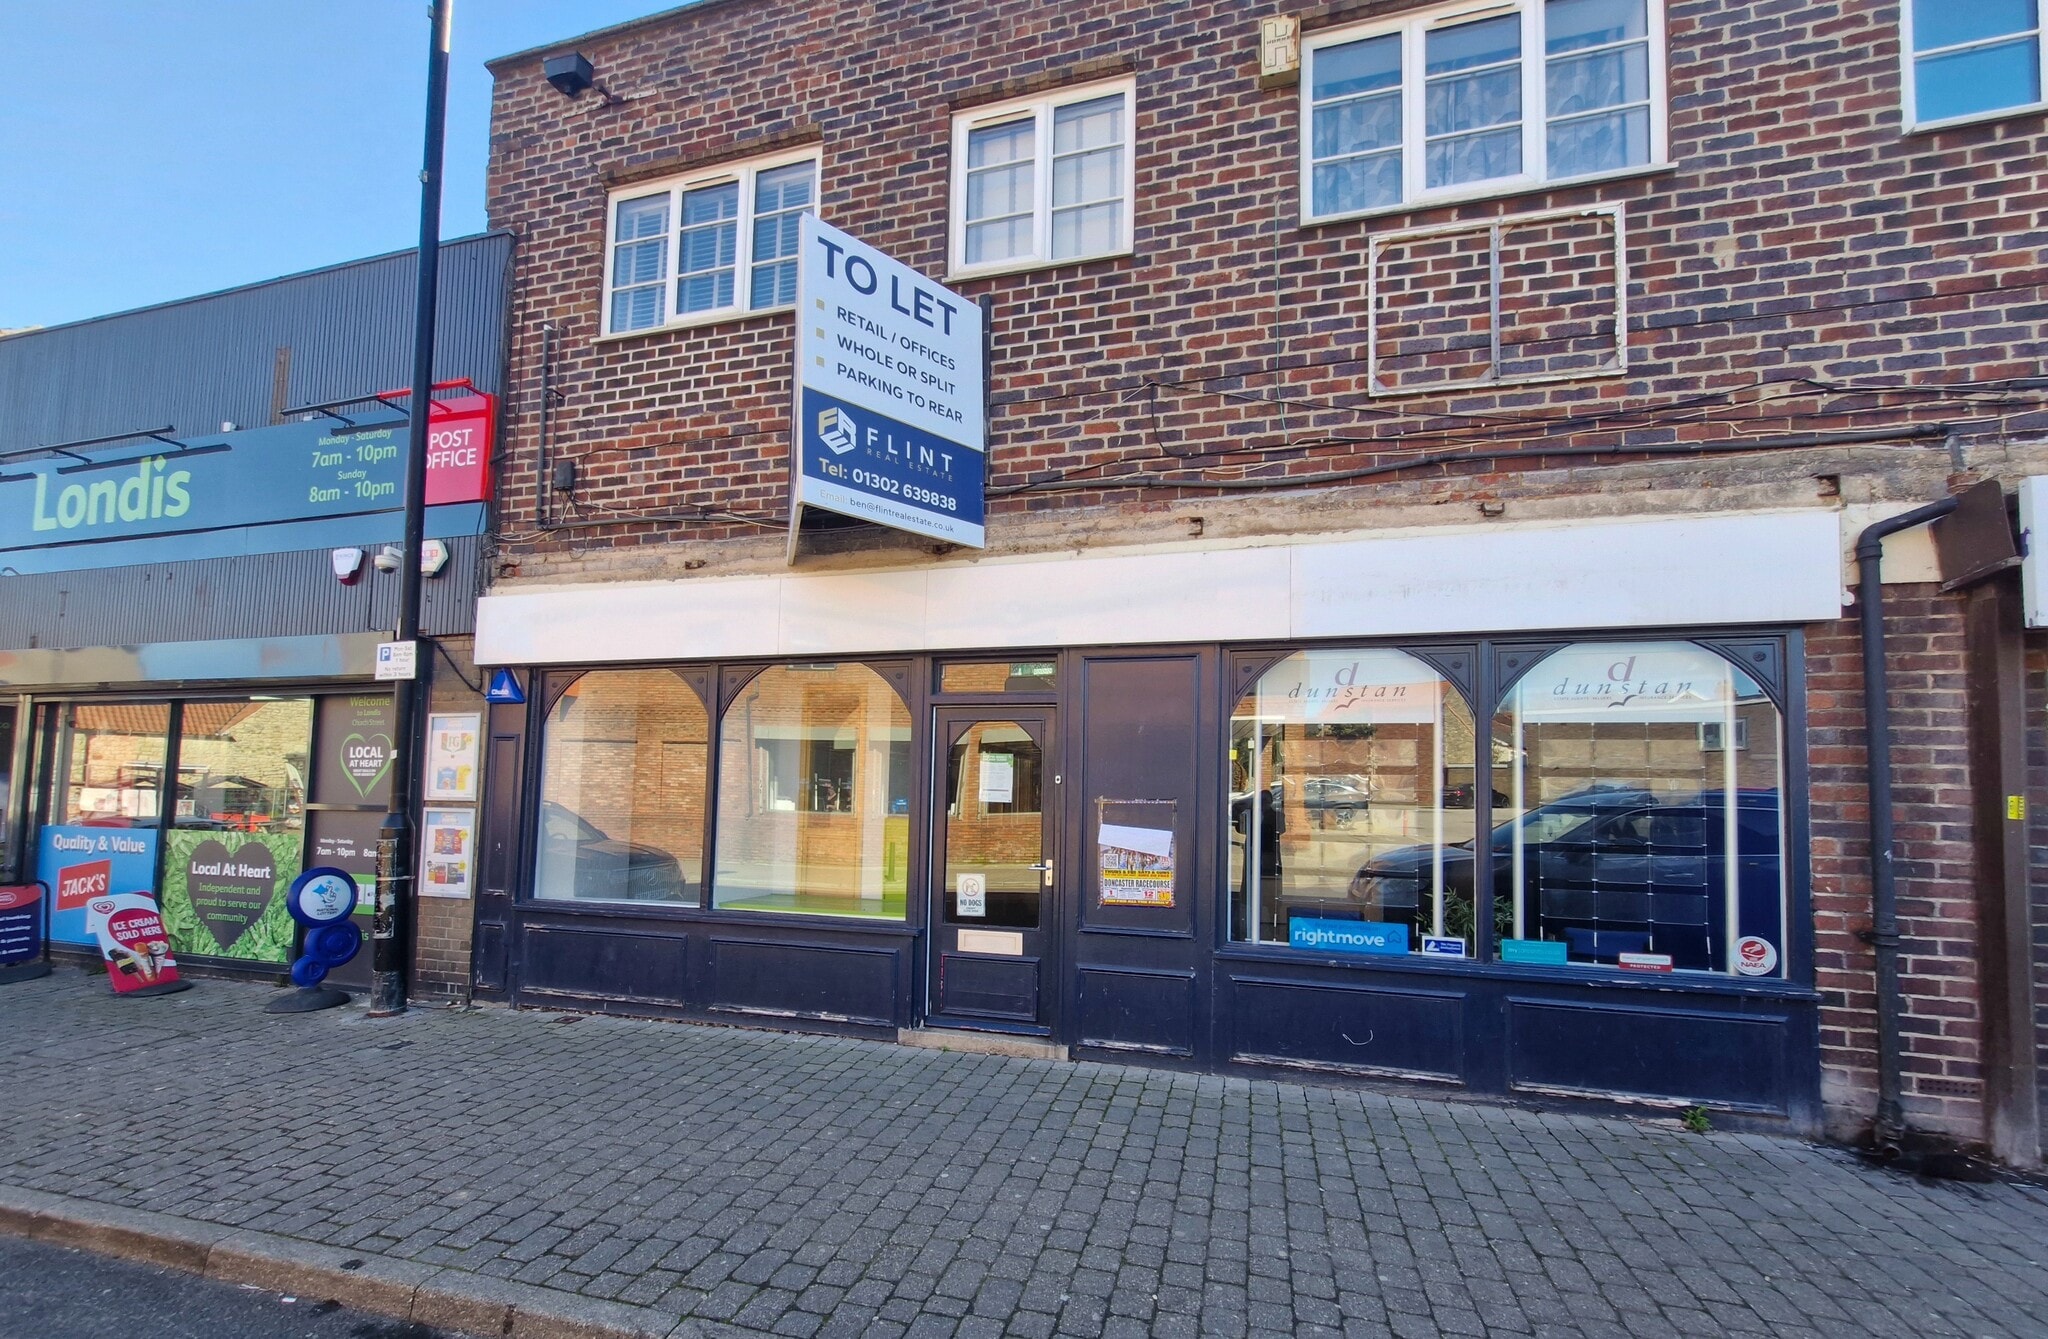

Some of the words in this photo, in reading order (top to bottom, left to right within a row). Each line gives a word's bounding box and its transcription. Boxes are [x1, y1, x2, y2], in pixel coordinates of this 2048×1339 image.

[817, 235, 878, 296] TO
[891, 274, 957, 336] LET
[837, 306, 888, 341] RETAIL
[891, 332, 897, 343] /
[899, 336, 955, 371] OFFICES
[837, 333, 893, 370] WHOLE
[897, 361, 917, 380] OR
[920, 371, 956, 395] SPLIT
[837, 362, 904, 400] PARKING
[907, 390, 925, 408] TO
[928, 400, 963, 424] REAR
[318, 436, 350, 446] Monday
[355, 428, 392, 442] Saturday
[429, 429, 473, 449] POST
[312, 450, 343, 468] 7am
[356, 443, 398, 465] 10pm
[867, 427, 953, 472] FLINT
[866, 447, 900, 465] REAL
[909, 462, 953, 482] ESTATE
[337, 469, 367, 480] Sunday
[819, 457, 848, 480] Tel:
[852, 468, 899, 495] 01302
[903, 483, 957, 511] 639838
[32, 455, 191, 531] Londis
[309, 486, 341, 503] 8am
[354, 480, 395, 500] 10pm
[820, 489, 848, 504] Email:
[850, 497, 955, 533] ben@flintrealestate.co.uk
[381, 648, 391, 661] P
[1334, 661, 1359, 686] d
[1607, 655, 1637, 682] d
[1288, 682, 1407, 699] dunstan
[1552, 677, 1693, 696] dunstan
[350, 696, 390, 707] Welcome
[349, 746, 384, 759] LOCAL
[349, 759, 359, 768] AT
[360, 759, 383, 768] HEART
[53, 834, 96, 854] Quality
[98, 835, 108, 851] &
[111, 836, 146, 853] Value
[316, 846, 332, 856] 7am
[336, 847, 356, 859] 10pm
[192, 861, 221, 876] Local
[222, 862, 237, 877] At
[238, 863, 271, 879] Heart
[62, 873, 106, 897] JACK'S
[198, 882, 245, 894] Independent
[246, 886, 261, 896] and
[1104, 878, 1135, 887] DONCASTER
[1136, 880, 1170, 888] RACECOURSE
[196, 897, 217, 907] proud
[218, 899, 227, 908] to
[227, 901, 247, 909] serve
[248, 901, 262, 910] our
[968, 899, 982, 907] DOGS
[112, 921, 127, 931] ICE
[128, 916, 160, 928] CREAM
[206, 912, 249, 925] community
[116, 931, 140, 941] SOLD
[142, 926, 163, 937] HERE
[1294, 928, 1385, 947] rightmove
